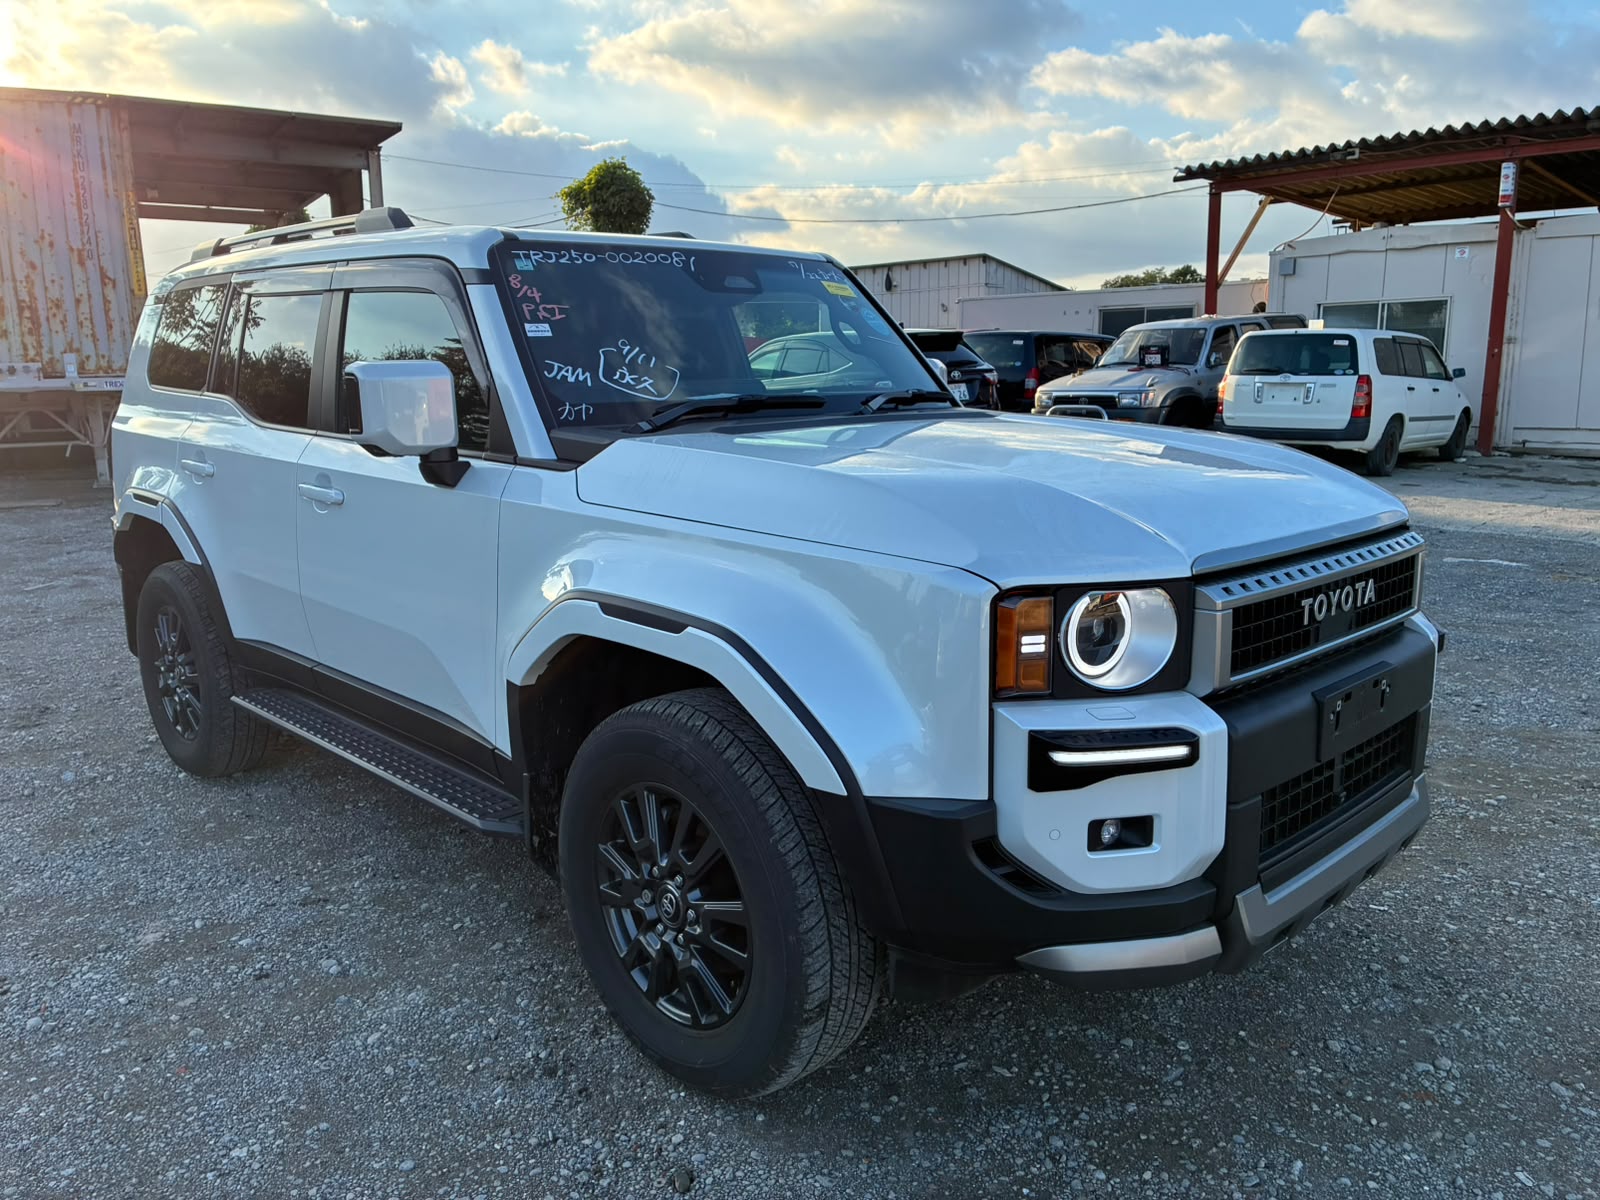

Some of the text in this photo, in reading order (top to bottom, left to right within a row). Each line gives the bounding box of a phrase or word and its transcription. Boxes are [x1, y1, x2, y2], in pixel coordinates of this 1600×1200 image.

[511, 249, 695, 272] TRJ250-0020081
[544, 360, 592, 387] JAM
[1301, 578, 1376, 625] TOYOTA
